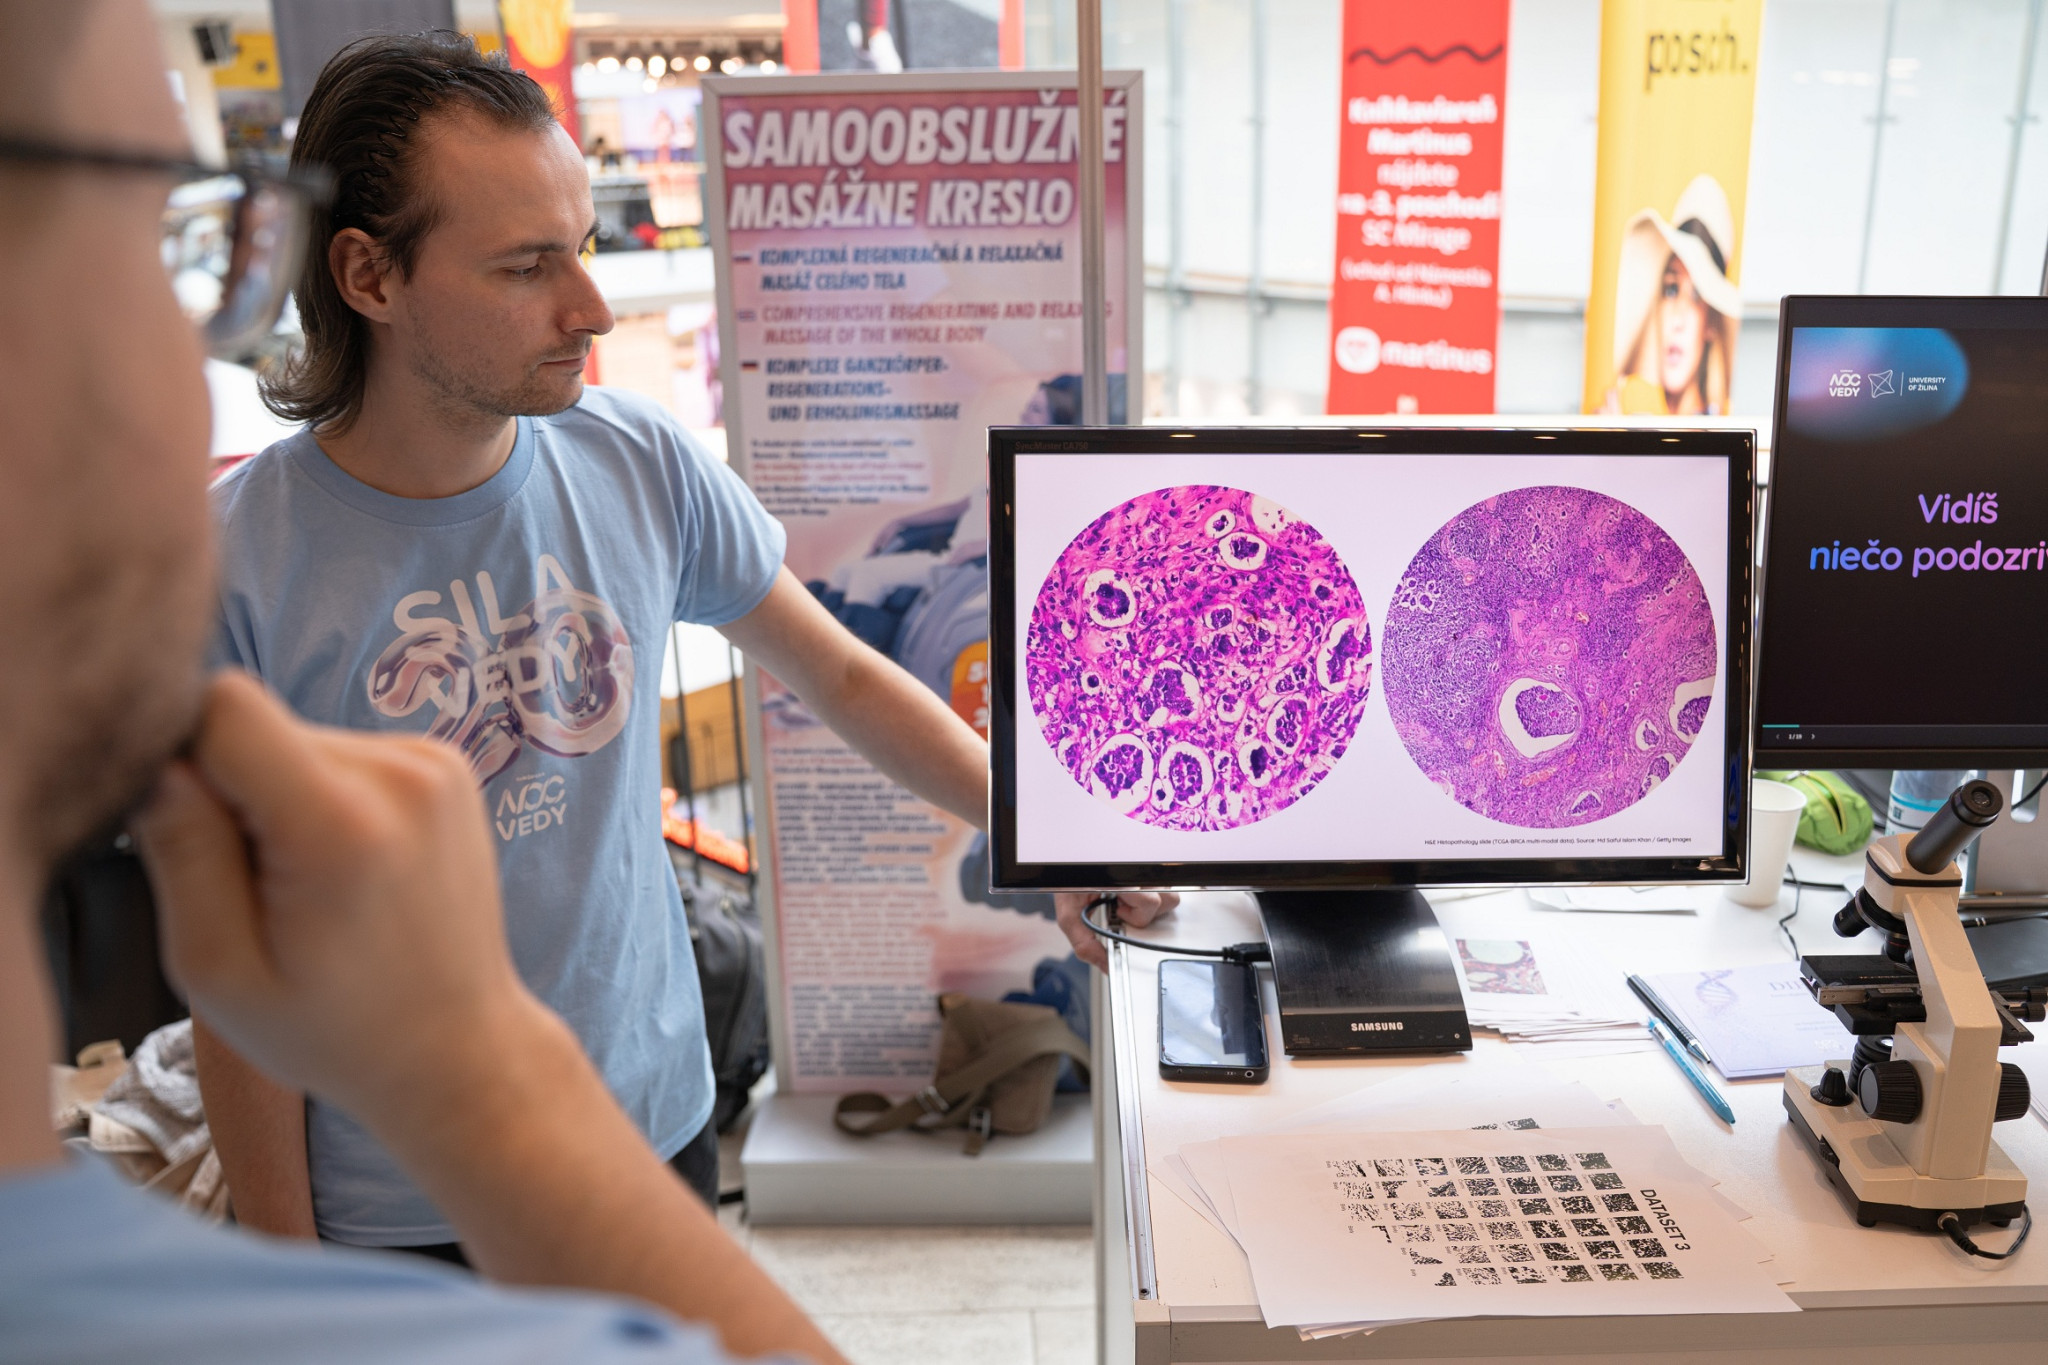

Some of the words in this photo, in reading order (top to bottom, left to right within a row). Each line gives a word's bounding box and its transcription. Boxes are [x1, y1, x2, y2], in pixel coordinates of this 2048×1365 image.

[729, 168, 920, 231] MASÁŽNE
[927, 178, 1074, 227] KRESLO
[963, 246, 974, 263] A
[873, 272, 907, 290] TELA
[1004, 301, 1037, 319] AND
[836, 326, 857, 345] OF
[945, 325, 988, 343] BODY
[1829, 387, 1861, 397] VEDY
[1917, 383, 1938, 391] ŽILINA
[768, 405, 800, 422] UND
[1918, 492, 1999, 524] Vidíš
[1810, 539, 1903, 571] niečo
[1912, 540, 2048, 578] podozri
[496, 802, 567, 841] VEDY
[1351, 1022, 1404, 1032] SAMSUNG
[1640, 1188, 1687, 1241] DATASET
[1674, 1242, 1692, 1252] 3
